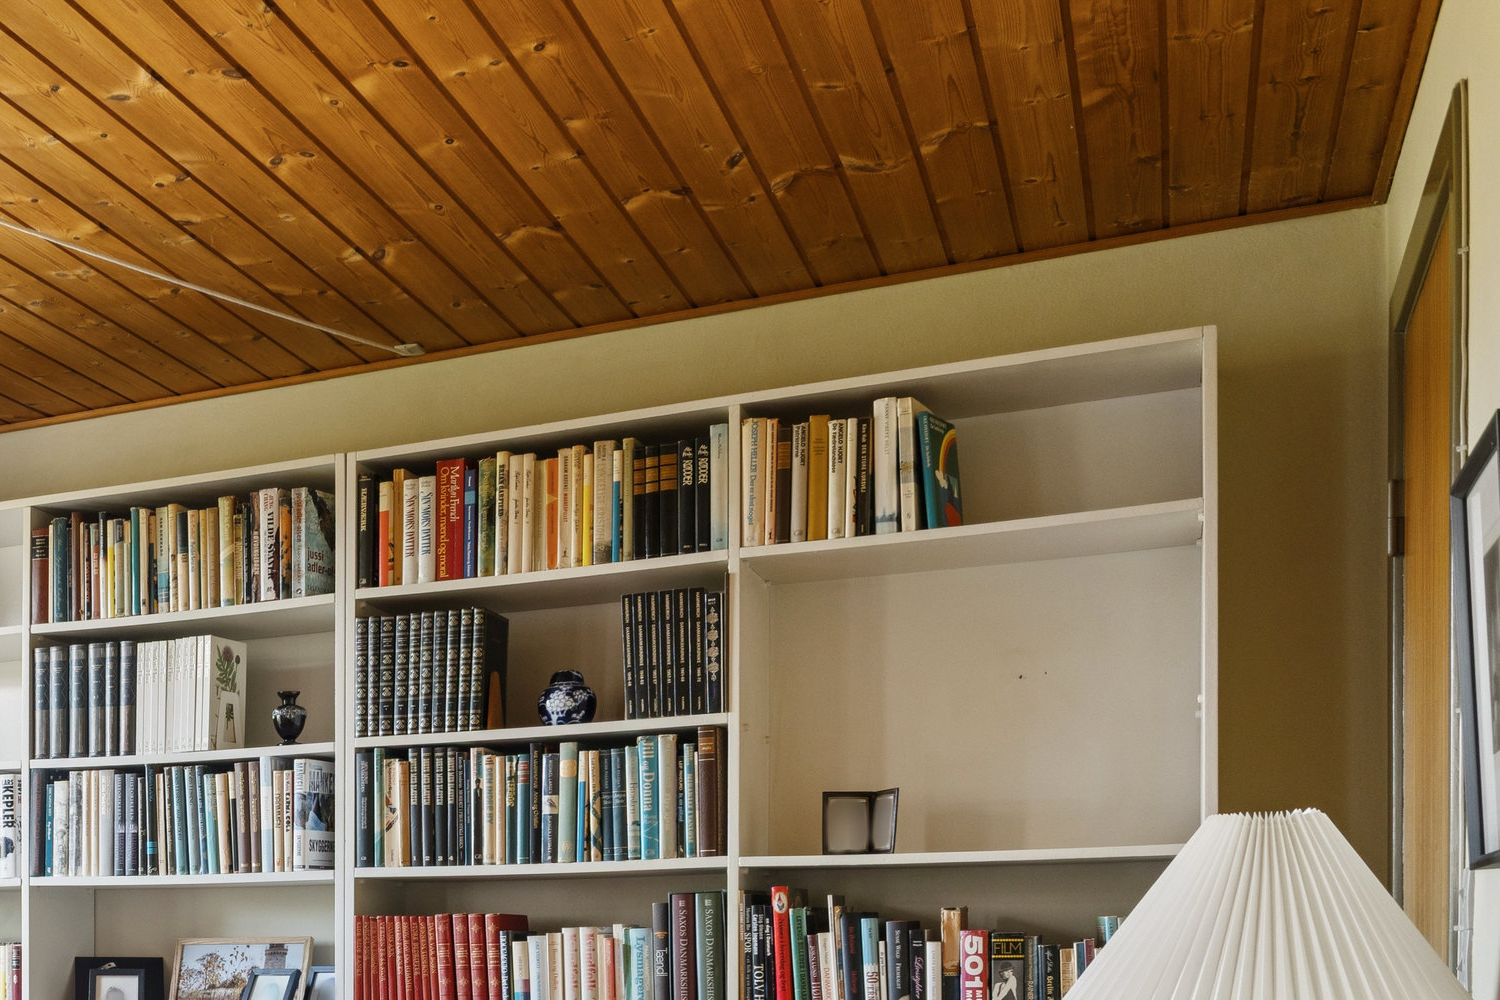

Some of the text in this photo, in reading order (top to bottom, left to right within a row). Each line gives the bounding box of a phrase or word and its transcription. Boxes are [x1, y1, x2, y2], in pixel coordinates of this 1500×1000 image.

[751, 421, 760, 446] JOSEPH
[682, 459, 694, 487] RØDDER
[698, 457, 709, 485] RØDDER
[750, 448, 759, 473] HELLER
[448, 466, 461, 522] Marilyn French
[360, 488, 368, 532] HÆRVÆRK
[437, 466, 451, 579] Om kvinder, mænd og moral
[266, 511, 276, 541] VILDE
[307, 548, 324, 562] jussi
[404, 531, 415, 558] DATTER
[420, 529, 431, 556] DATTER
[641, 739, 655, 812] Jill og Donna
[2, 786, 16, 829] KEPLER
[679, 909, 688, 937] SAXOS
[704, 908, 715, 936] SAXOS
[744, 932, 754, 954] SPOR
[993, 942, 1022, 955] FILM
[587, 933, 597, 991] Kvindfolk
[778, 945, 788, 970] hverdag
[964, 934, 984, 988] 501
[753, 963, 765, 992] TOLV
[1027, 980, 1036, 1000] RAINER
[1046, 976, 1054, 995] Berlin
